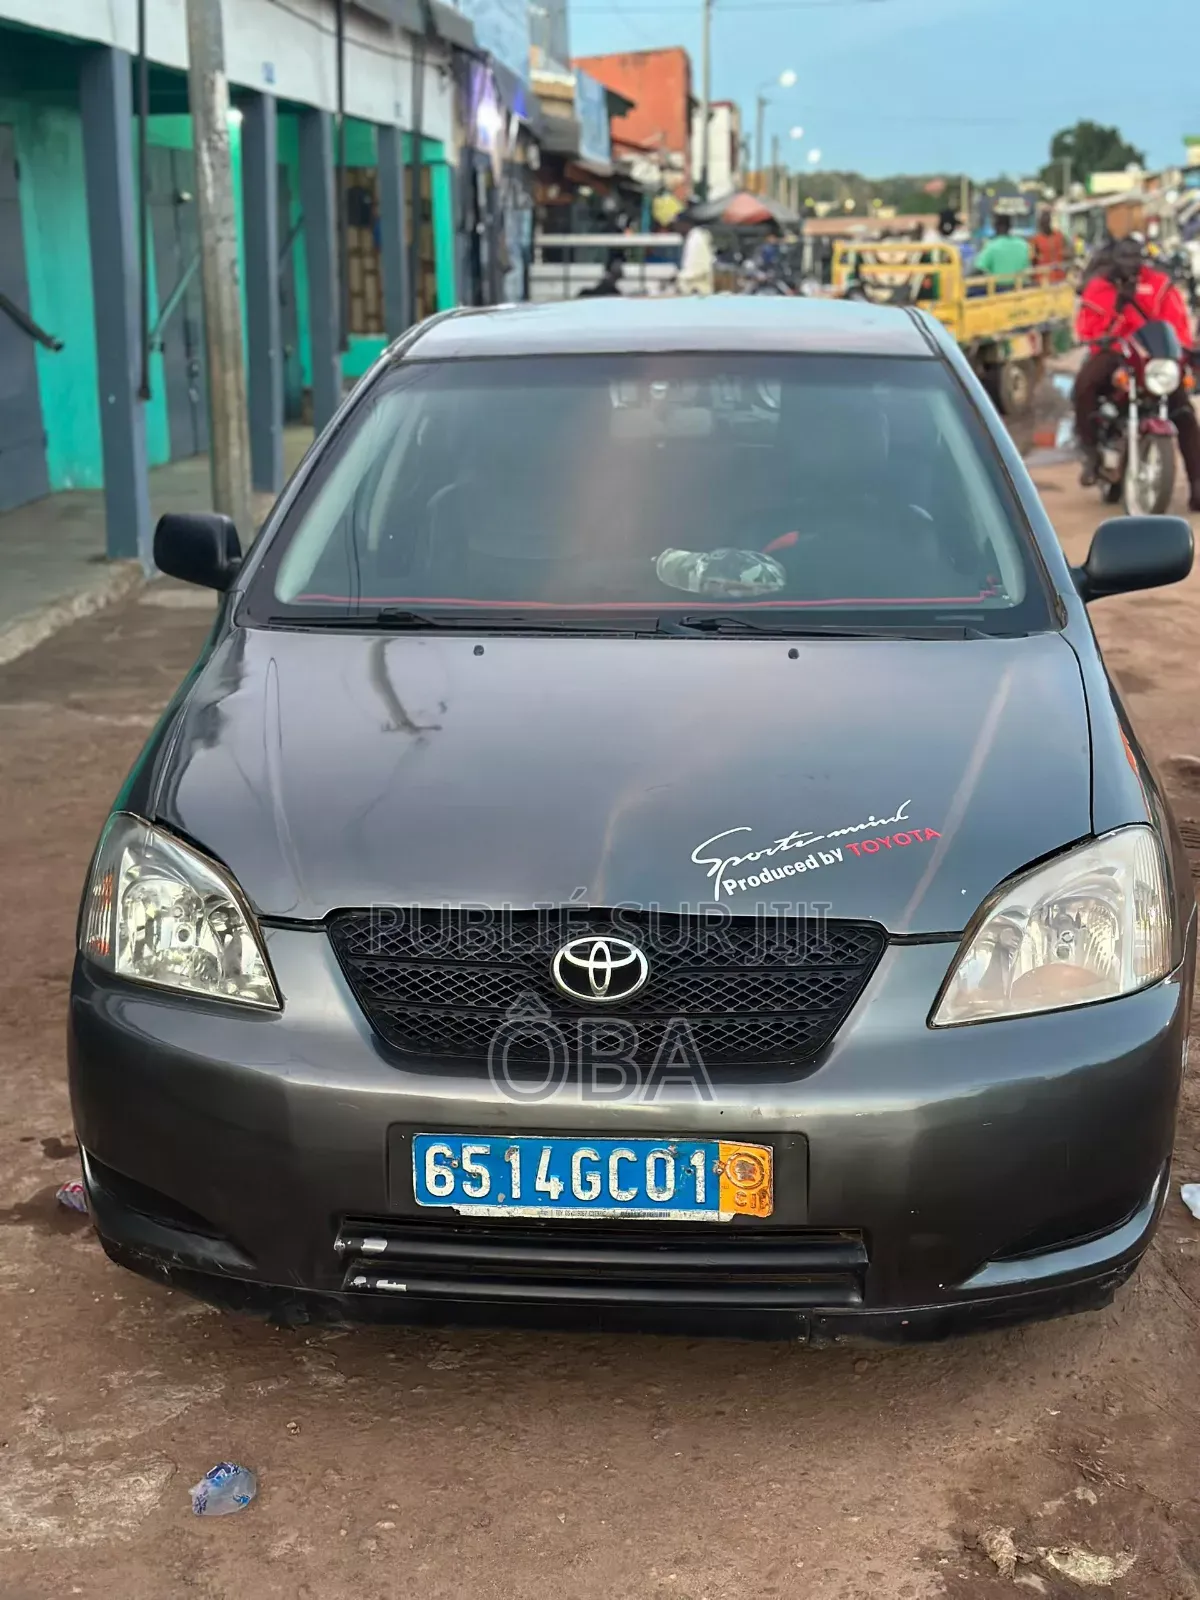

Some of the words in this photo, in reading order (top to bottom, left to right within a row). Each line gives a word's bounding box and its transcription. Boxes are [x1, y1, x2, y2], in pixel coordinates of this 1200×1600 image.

[722, 854, 820, 896] Produced
[817, 848, 844, 866] by
[845, 827, 942, 857] TOYOTA
